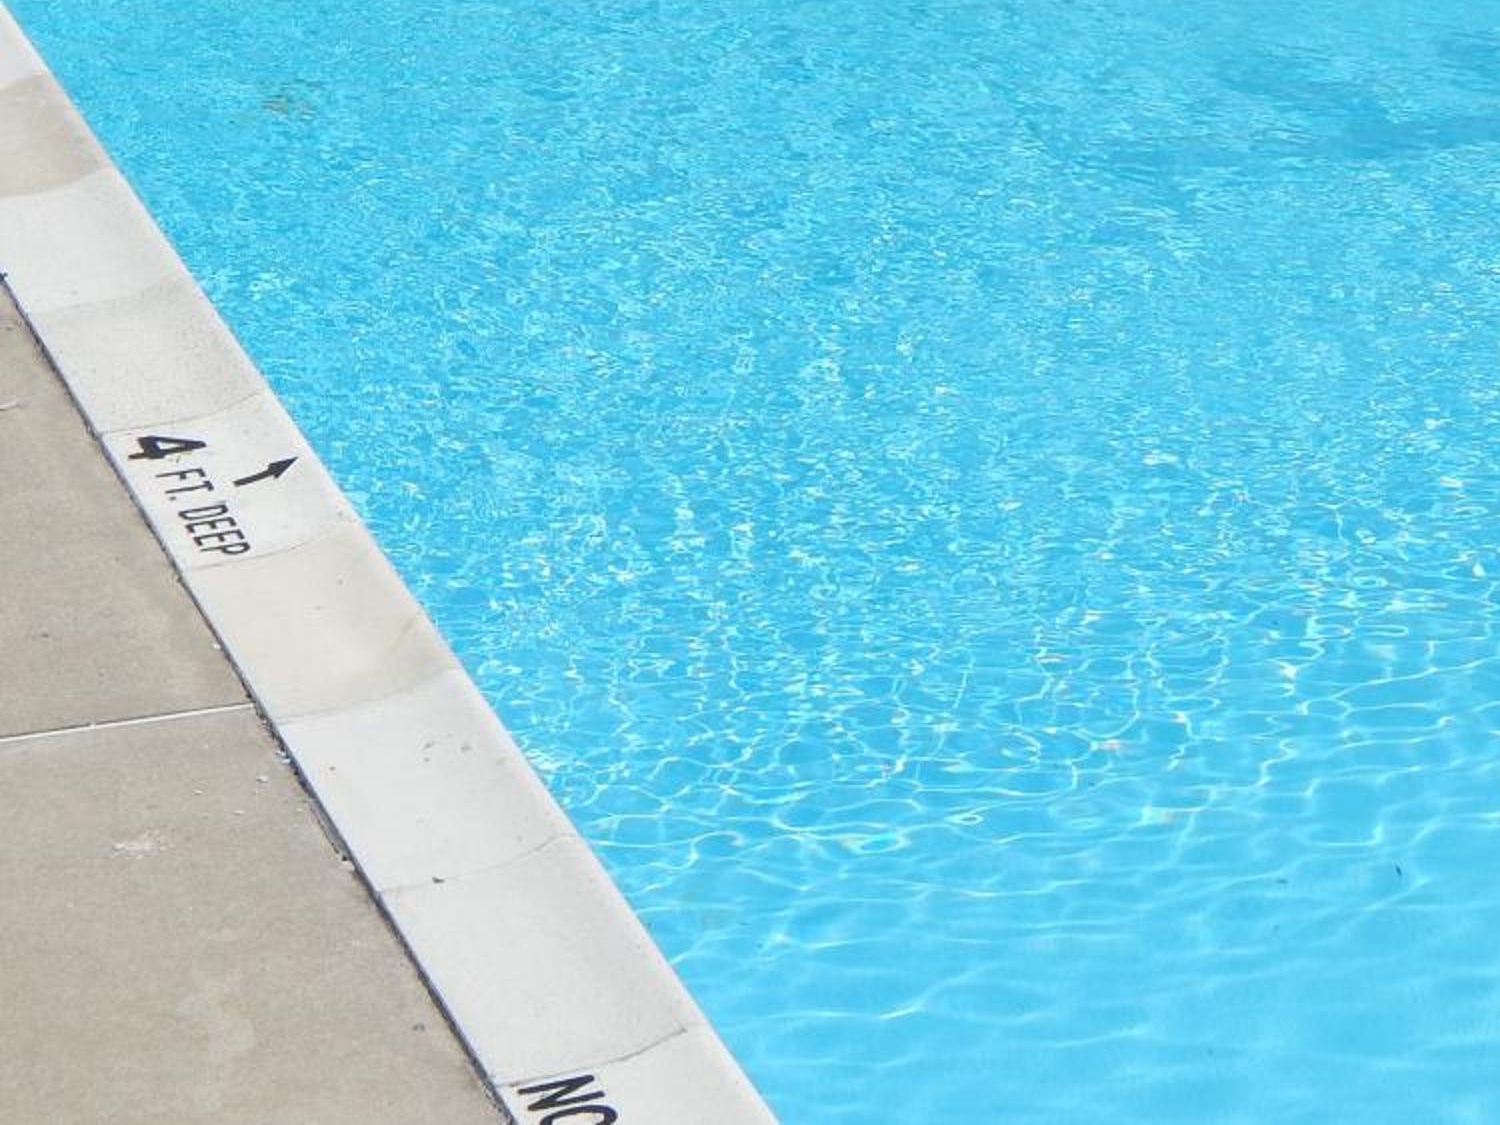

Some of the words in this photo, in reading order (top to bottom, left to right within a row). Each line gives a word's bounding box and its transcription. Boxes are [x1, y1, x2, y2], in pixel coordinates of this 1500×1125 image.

[128, 435, 207, 459] 4
[155, 467, 214, 502] FT.
[178, 502, 251, 556] DEEP
